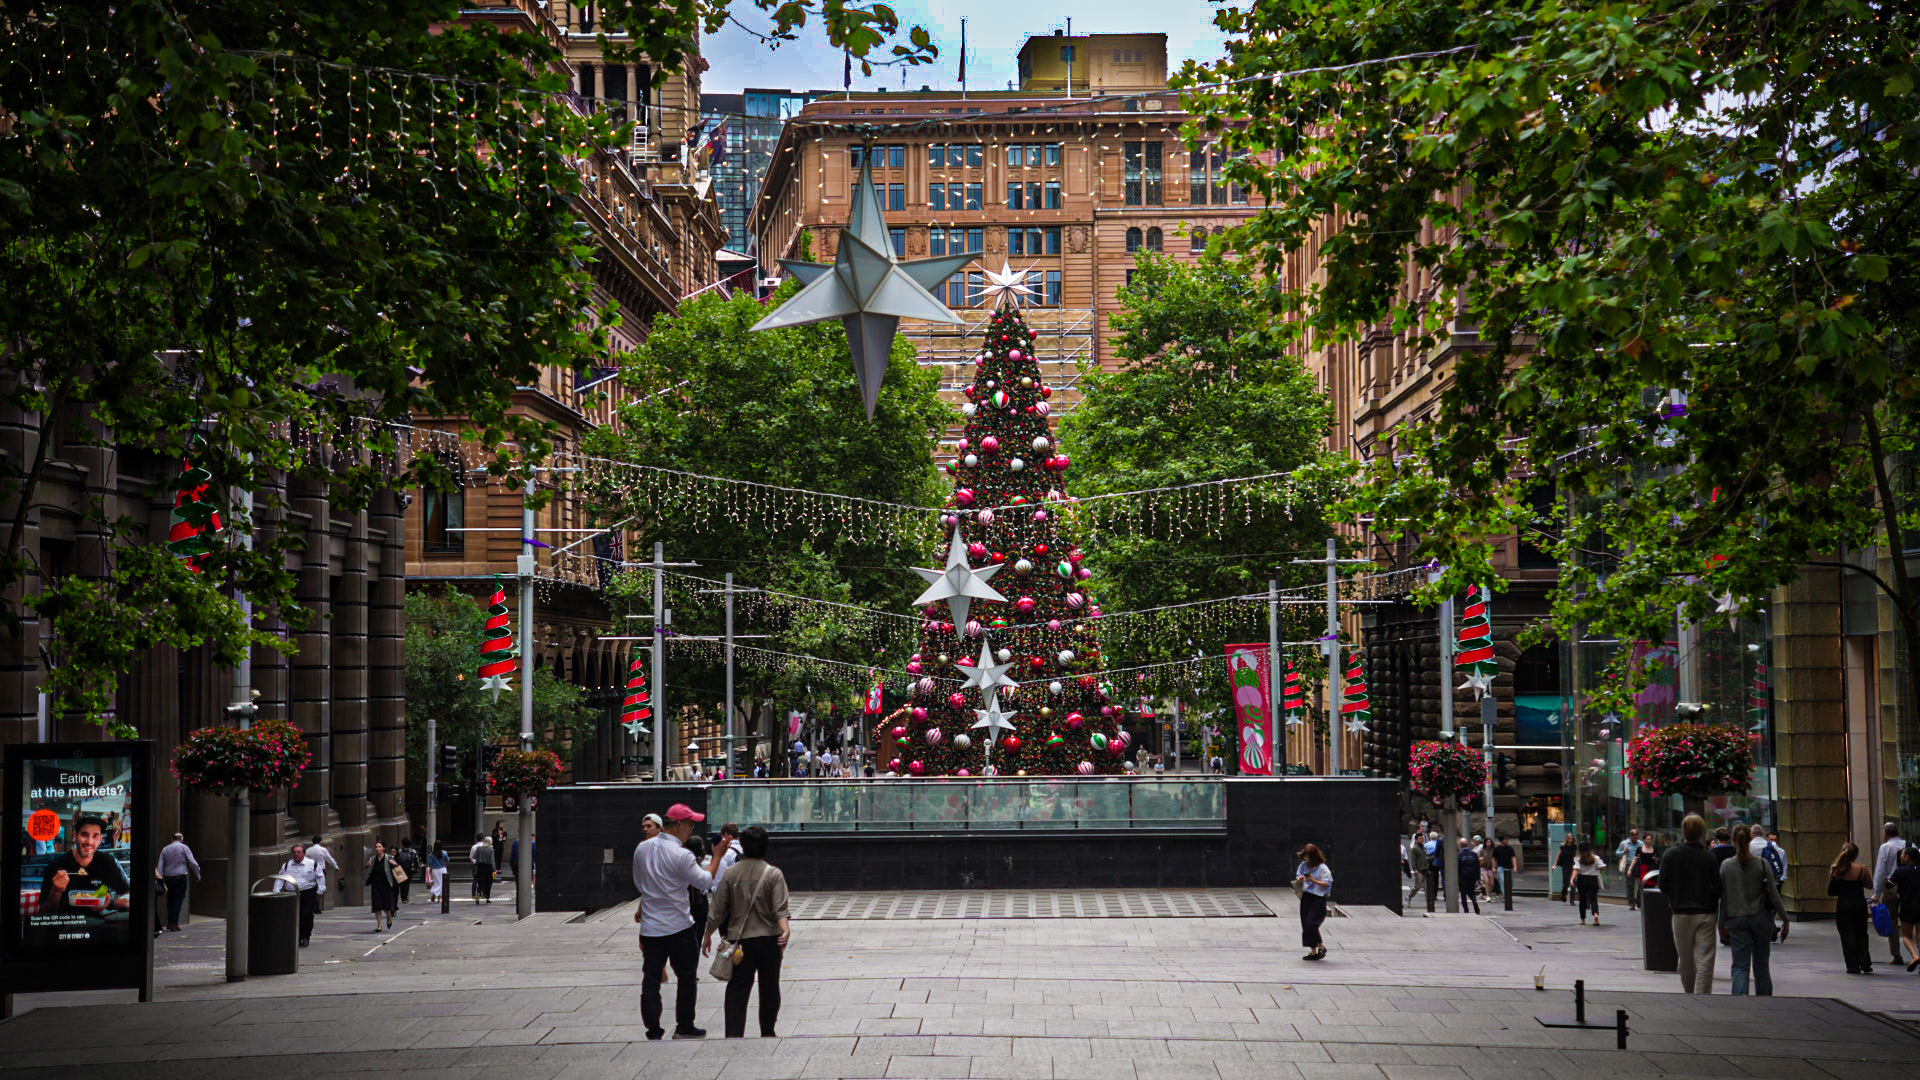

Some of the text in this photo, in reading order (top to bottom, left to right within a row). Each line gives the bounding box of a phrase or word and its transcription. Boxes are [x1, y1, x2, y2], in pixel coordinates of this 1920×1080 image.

[60, 773, 95, 785] Eating
[30, 784, 124, 798] at the markets?
